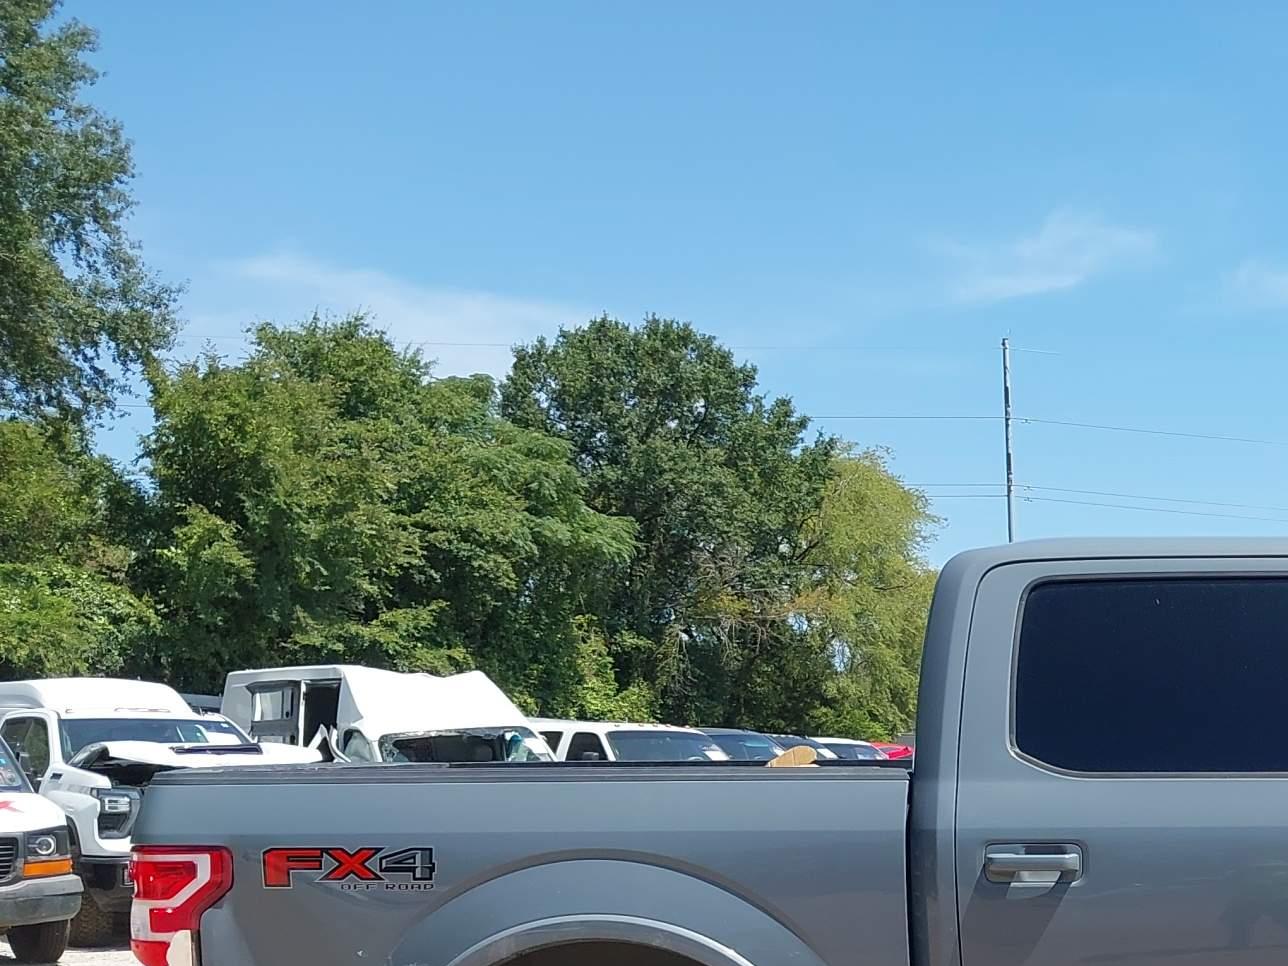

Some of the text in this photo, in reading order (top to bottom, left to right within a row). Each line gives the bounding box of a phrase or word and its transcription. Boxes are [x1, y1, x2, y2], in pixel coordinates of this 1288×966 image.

[262, 846, 436, 889] FX4
[340, 882, 434, 891] OFF ROAD
